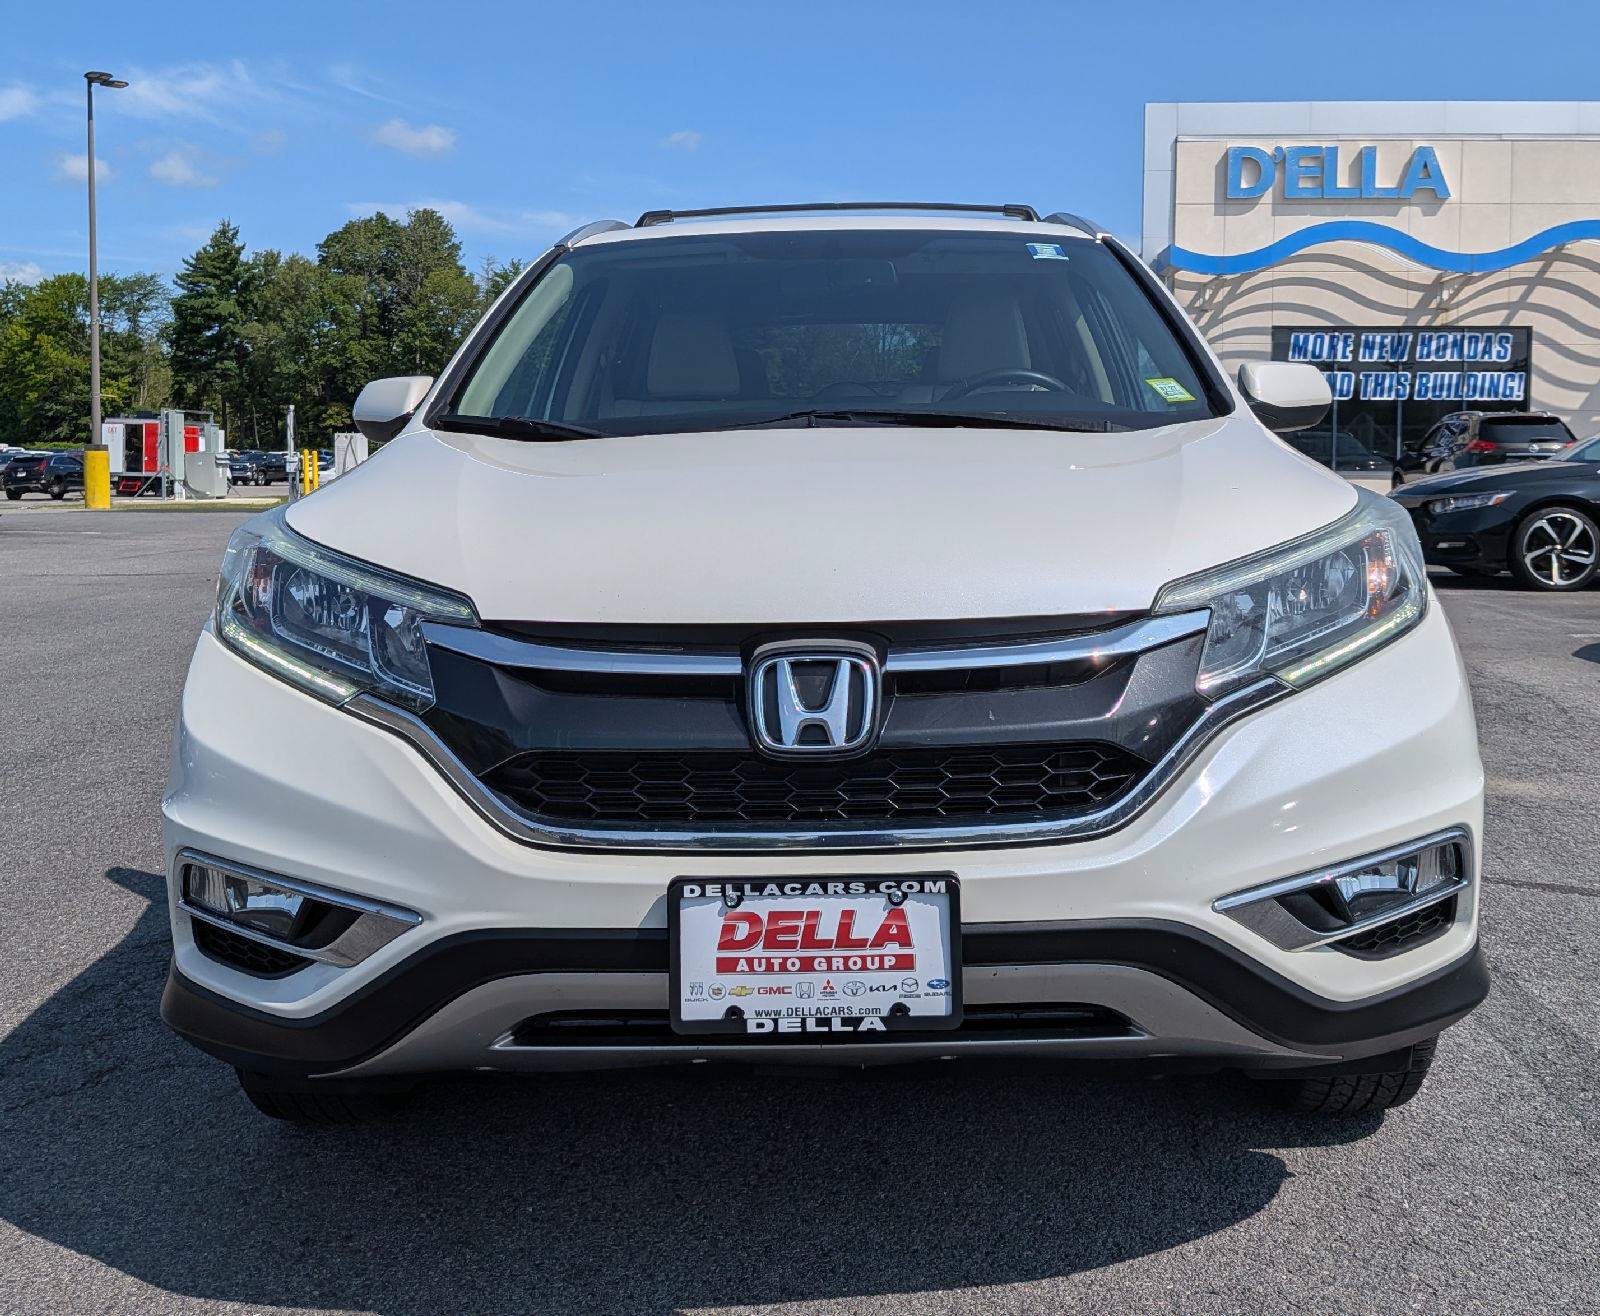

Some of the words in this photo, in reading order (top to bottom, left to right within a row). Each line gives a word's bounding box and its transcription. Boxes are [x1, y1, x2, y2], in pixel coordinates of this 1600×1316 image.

[1226, 145, 1452, 200] D'ELLA
[1288, 332, 1355, 362] MORE
[1358, 332, 1413, 362] NEW
[1359, 372, 1411, 401] THIS
[1414, 372, 1527, 401] BUILDING!
[683, 881, 947, 898] DELLACARS.COM
[716, 907, 915, 953] DELLA
[735, 957, 801, 973] AUTO
[813, 956, 897, 972] GROUP
[757, 986, 793, 995] GMC
[754, 1006, 881, 1017] www.DELLACARS.com
[746, 1016, 887, 1034] DELLA
